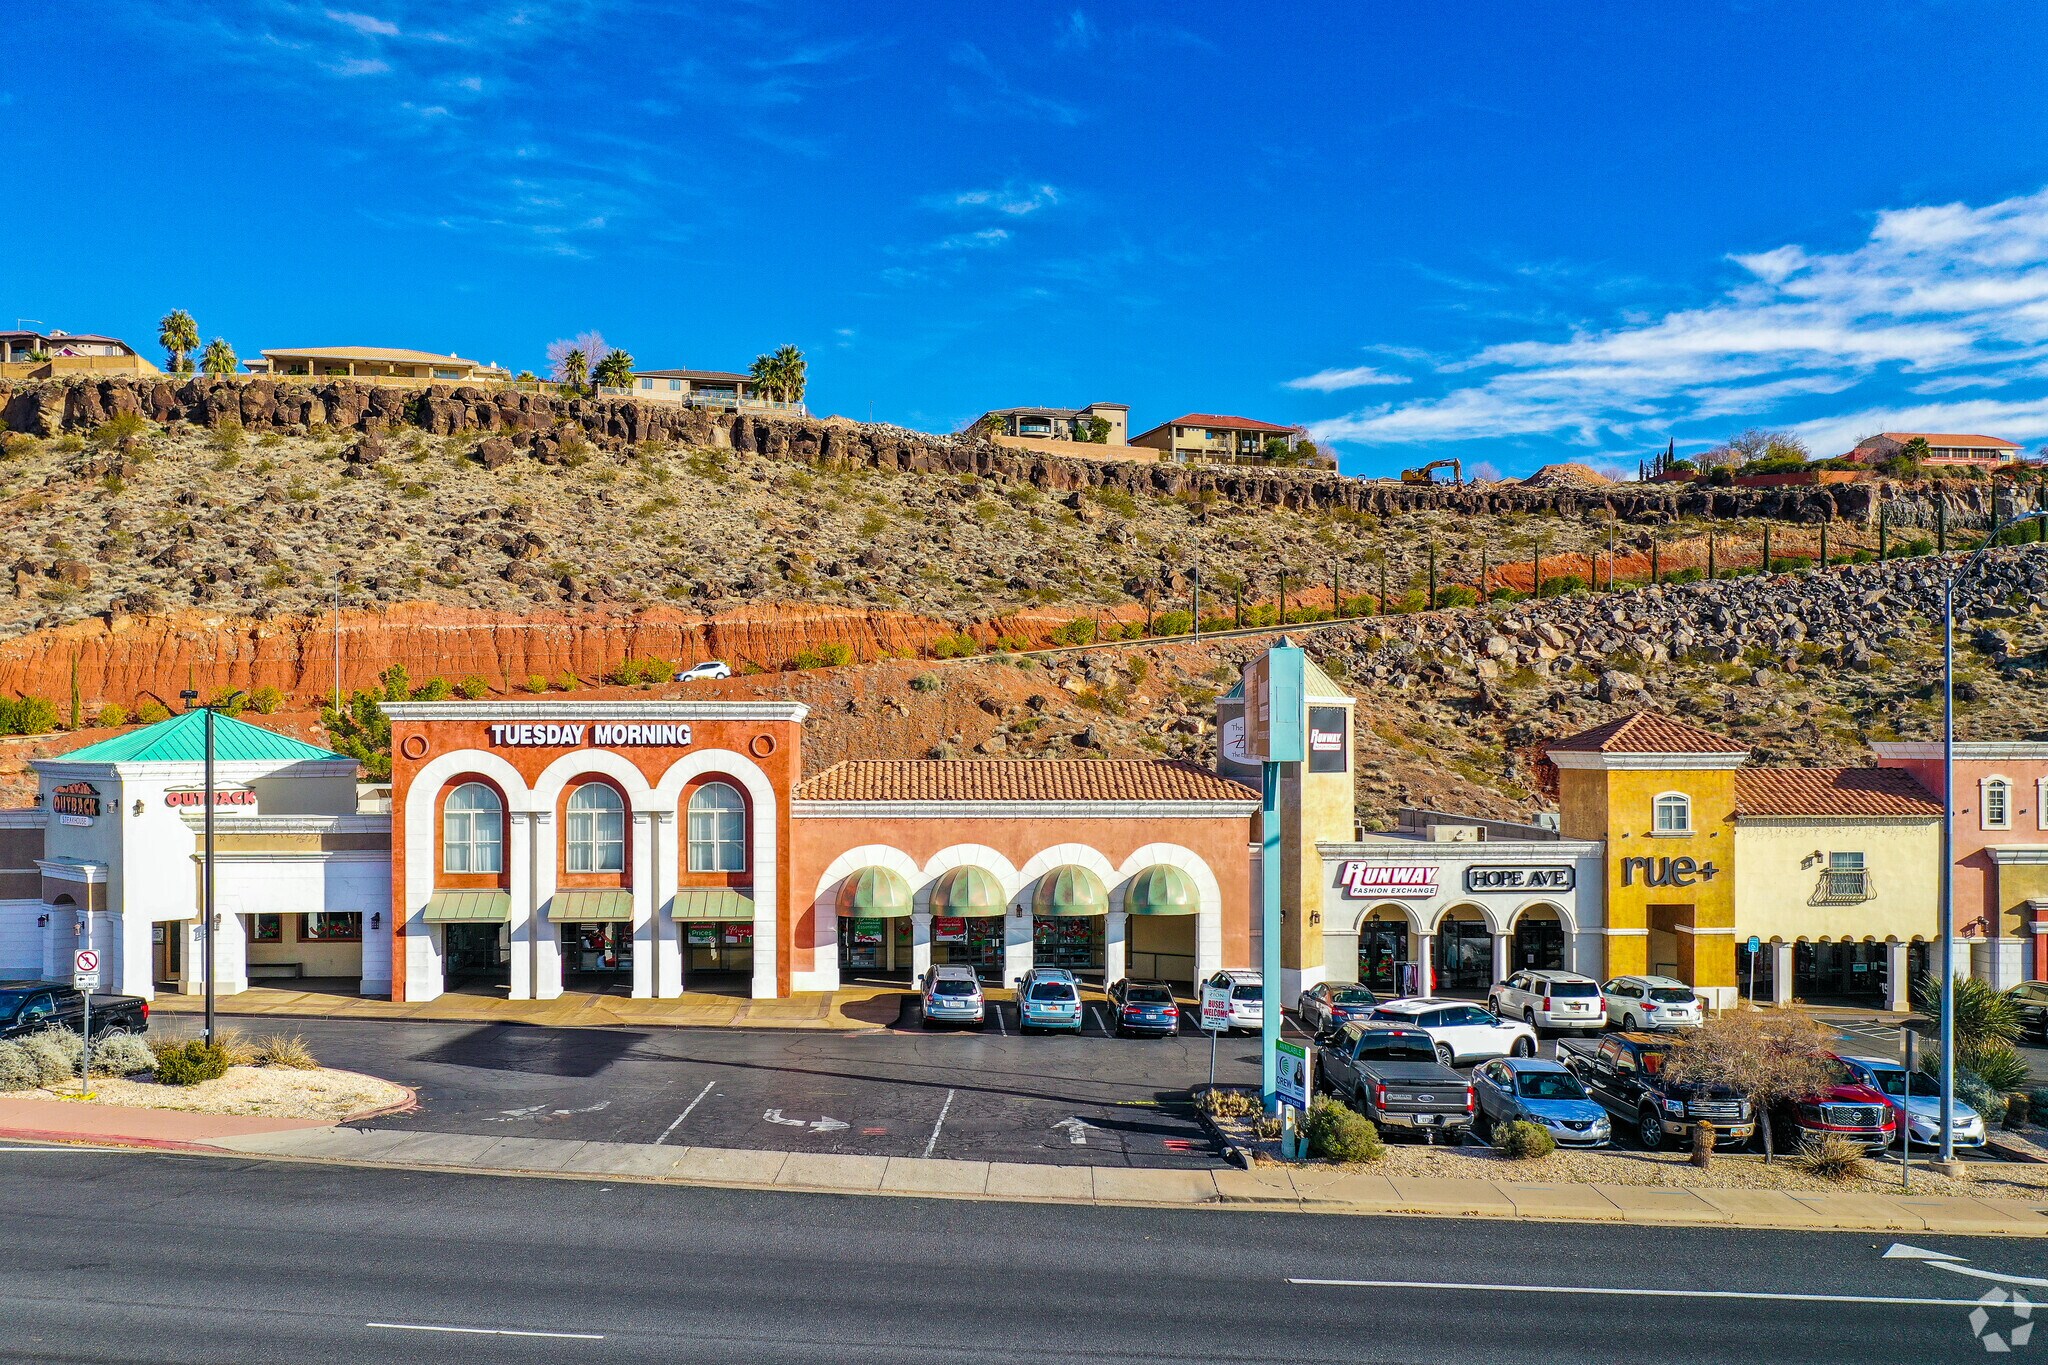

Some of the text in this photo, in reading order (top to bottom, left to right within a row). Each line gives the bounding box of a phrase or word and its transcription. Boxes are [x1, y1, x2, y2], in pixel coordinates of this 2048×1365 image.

[491, 724, 692, 745] TUESDAY MORNING
[1231, 723, 1243, 731] The
[1311, 729, 1342, 743] RUNWAY
[54, 794, 98, 815] OUTBACK
[165, 791, 256, 806] OUTACK
[1341, 861, 1440, 885] RUNWAY
[1473, 870, 1570, 886] HOPE AVE.
[1208, 1000, 1225, 1009] BUSES
[1203, 1008, 1228, 1018] WELCOME
[1279, 1042, 1302, 1057] AVAILABLE
[1276, 1075, 1293, 1089] CREW
